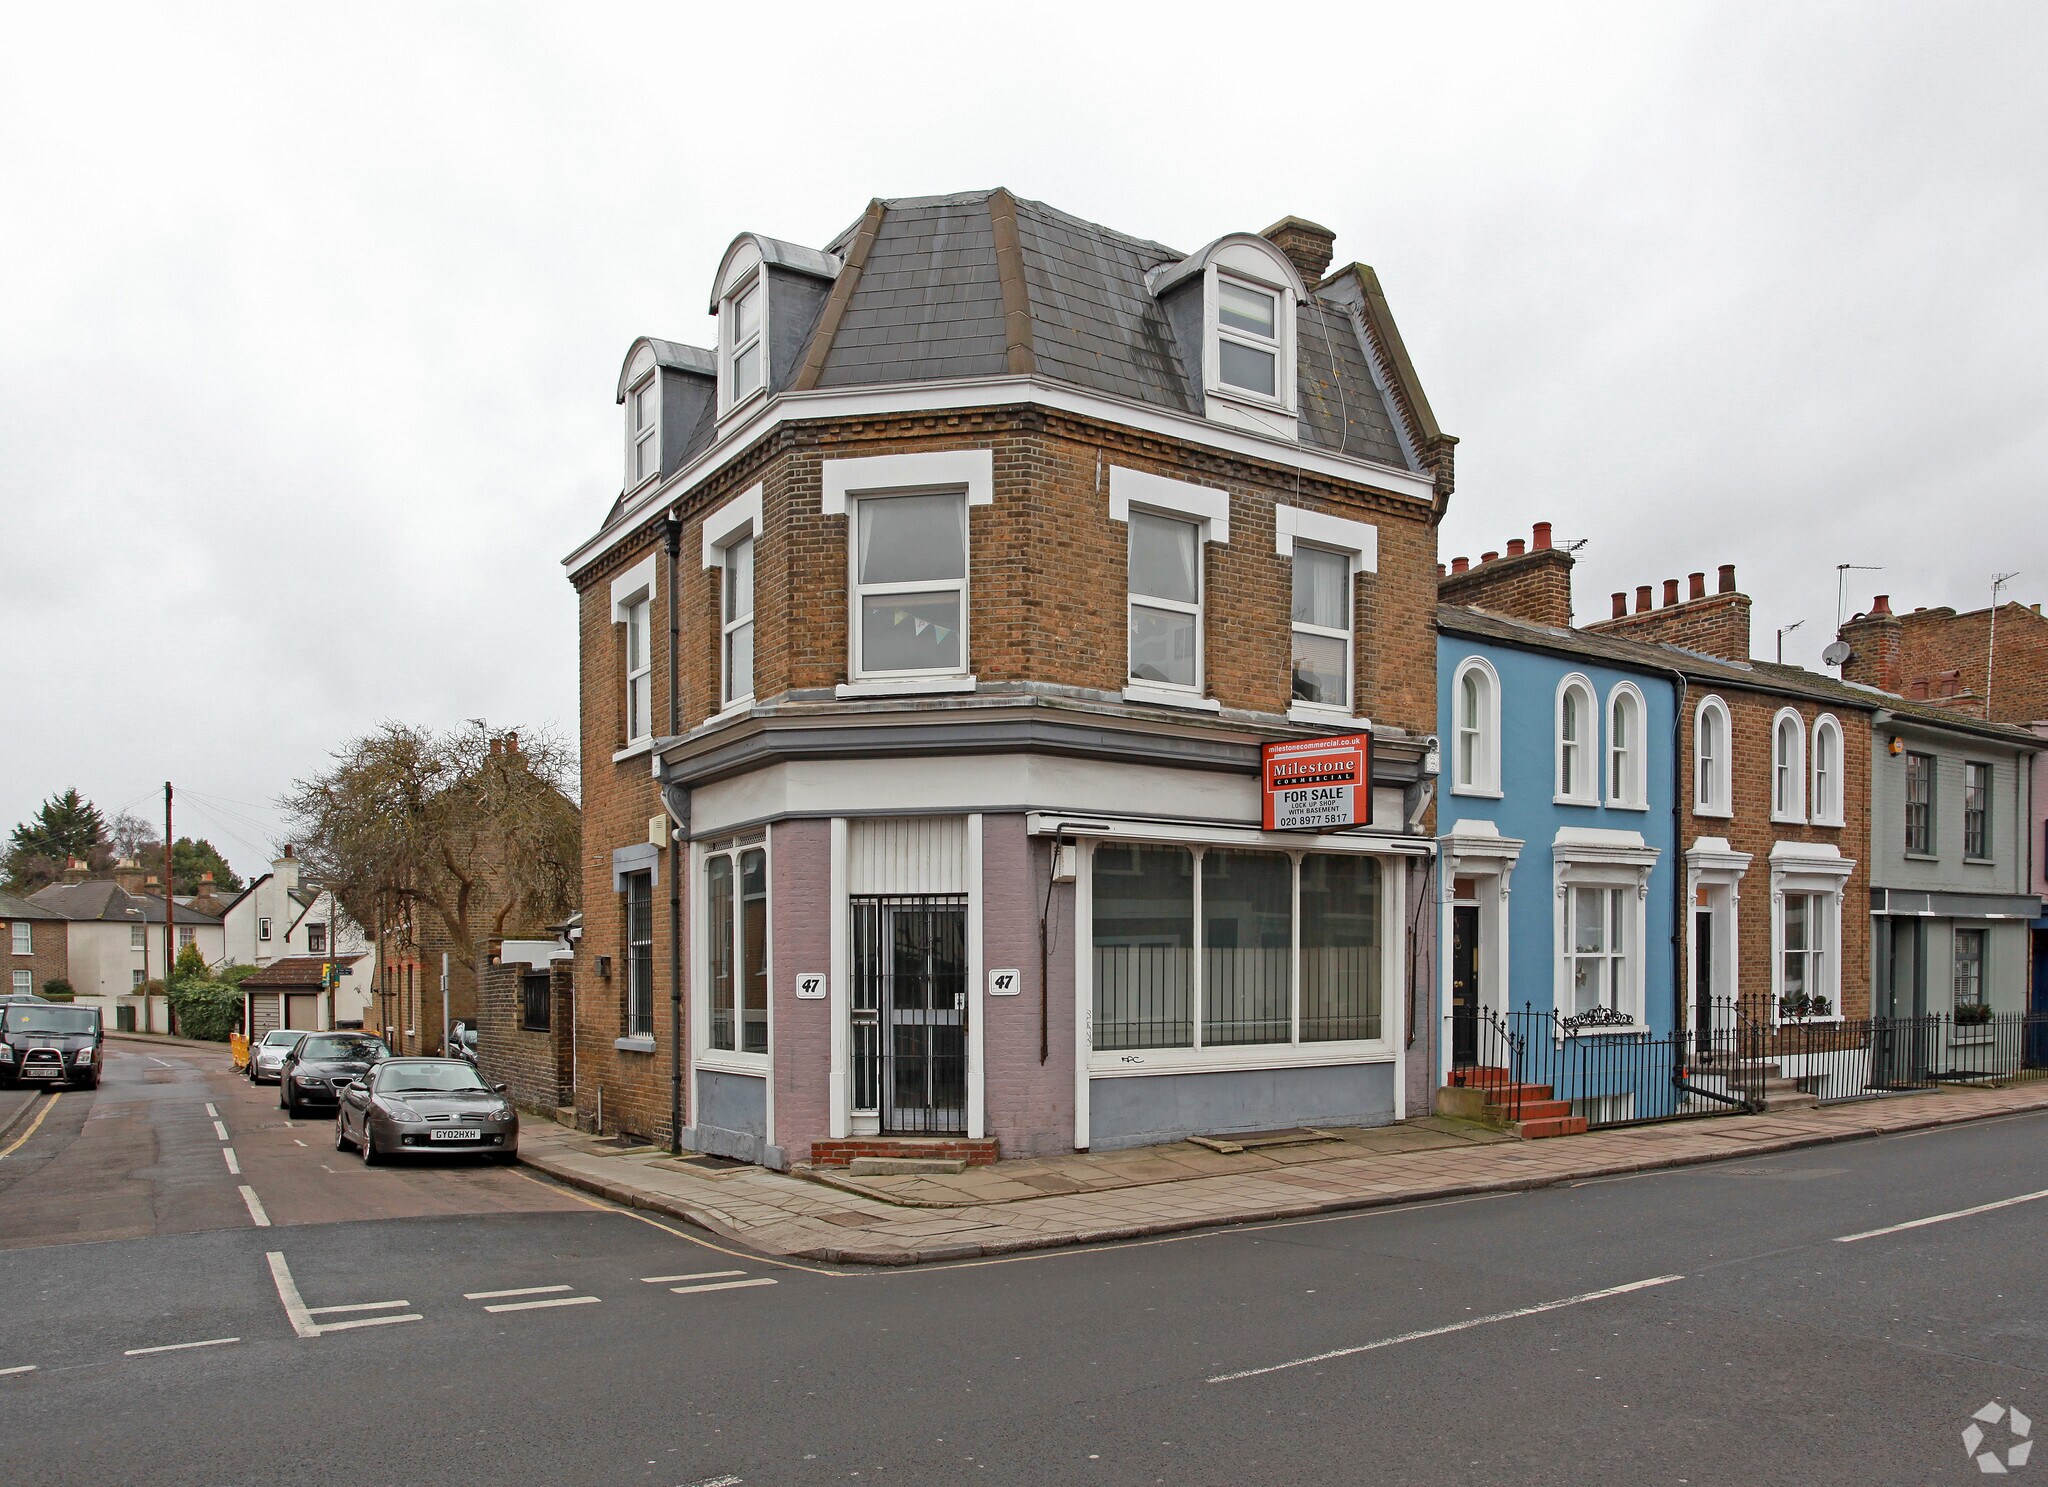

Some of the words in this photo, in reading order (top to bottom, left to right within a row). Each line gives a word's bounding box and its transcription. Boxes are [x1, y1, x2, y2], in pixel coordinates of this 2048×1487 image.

[1268, 738, 1360, 753] milestonecommercial.co.uk
[1273, 760, 1355, 776] Milestone
[1277, 774, 1350, 785] COMMERCIAL
[1284, 790, 1308, 803] FOR
[1311, 787, 1344, 801] SALE
[1288, 807, 1304, 815] WITH
[1306, 806, 1340, 814] BASEMENT
[1280, 817, 1297, 827] 020
[1299, 815, 1322, 826] 8977
[1325, 813, 1347, 824] 5817
[801, 979, 820, 993] 47
[994, 975, 1013, 989] 47
